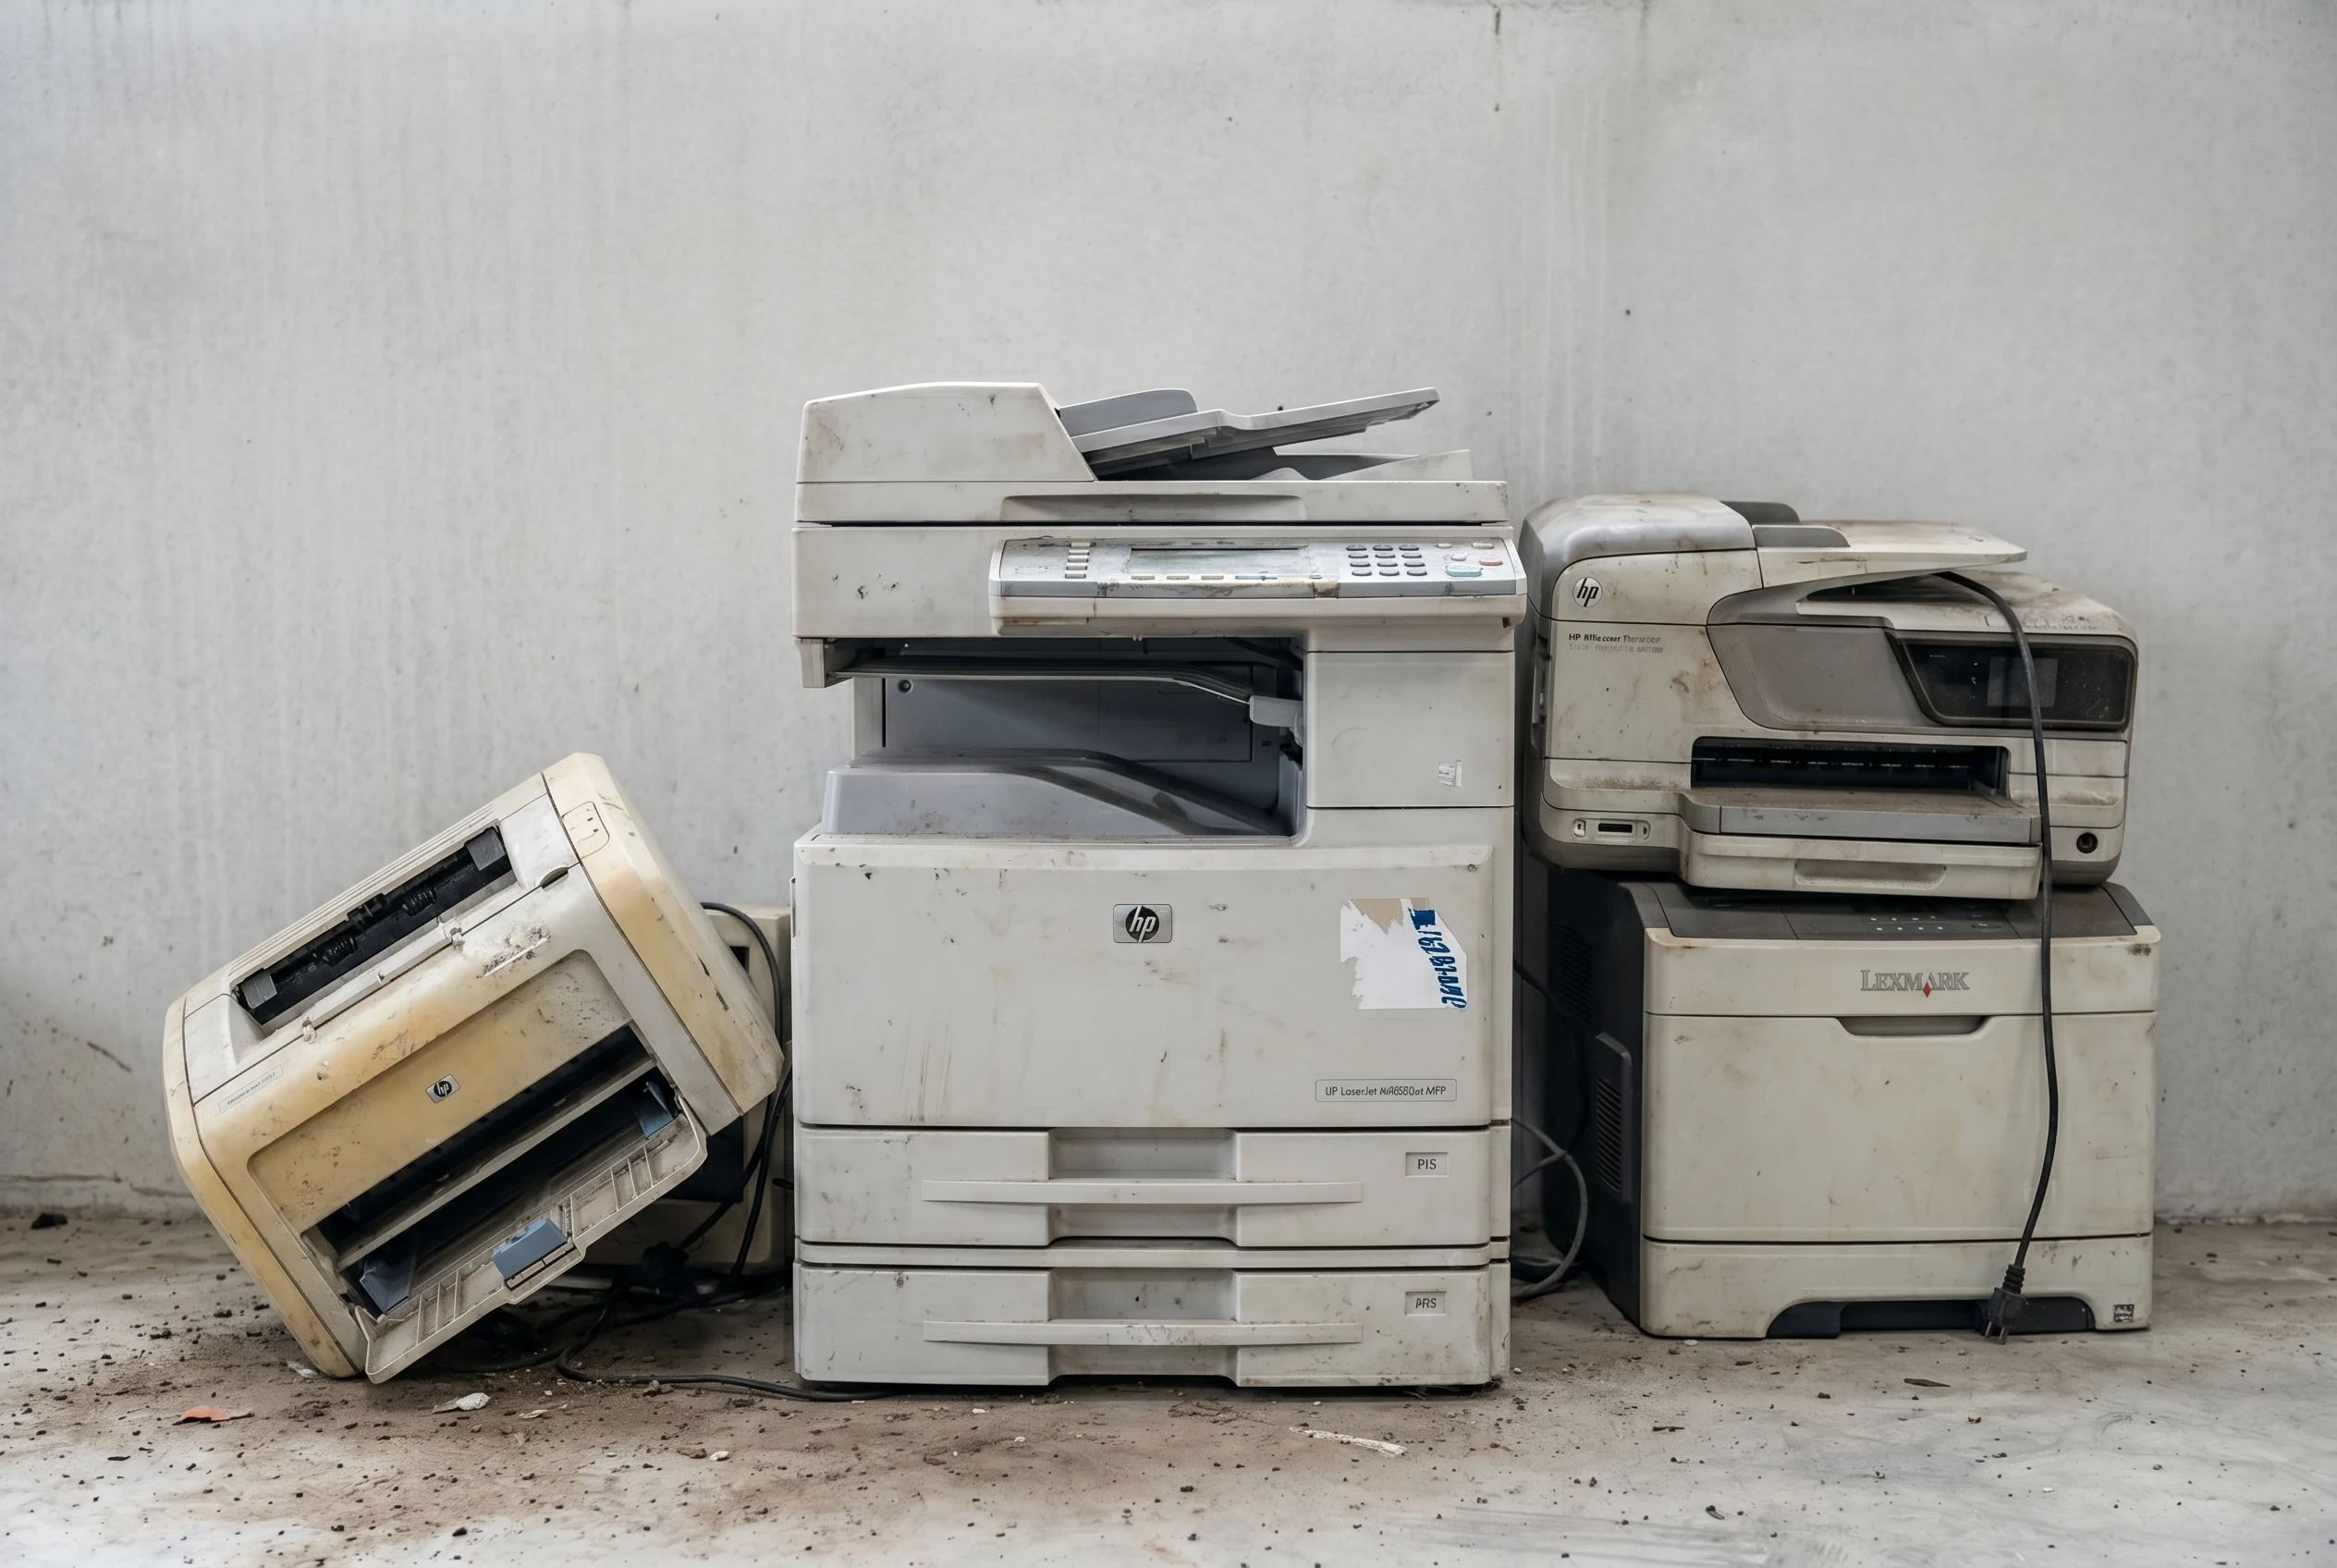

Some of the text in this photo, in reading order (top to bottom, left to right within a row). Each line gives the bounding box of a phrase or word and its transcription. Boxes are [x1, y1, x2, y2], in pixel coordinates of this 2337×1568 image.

[1575, 577, 1599, 607] hp
[1128, 905, 1157, 943] hp
[435, 1082, 450, 1097] hp
[1340, 1085, 1377, 1096] LaserJet
[1425, 1086, 1447, 1096] MFP
[1417, 1158, 1437, 1170] PIS
